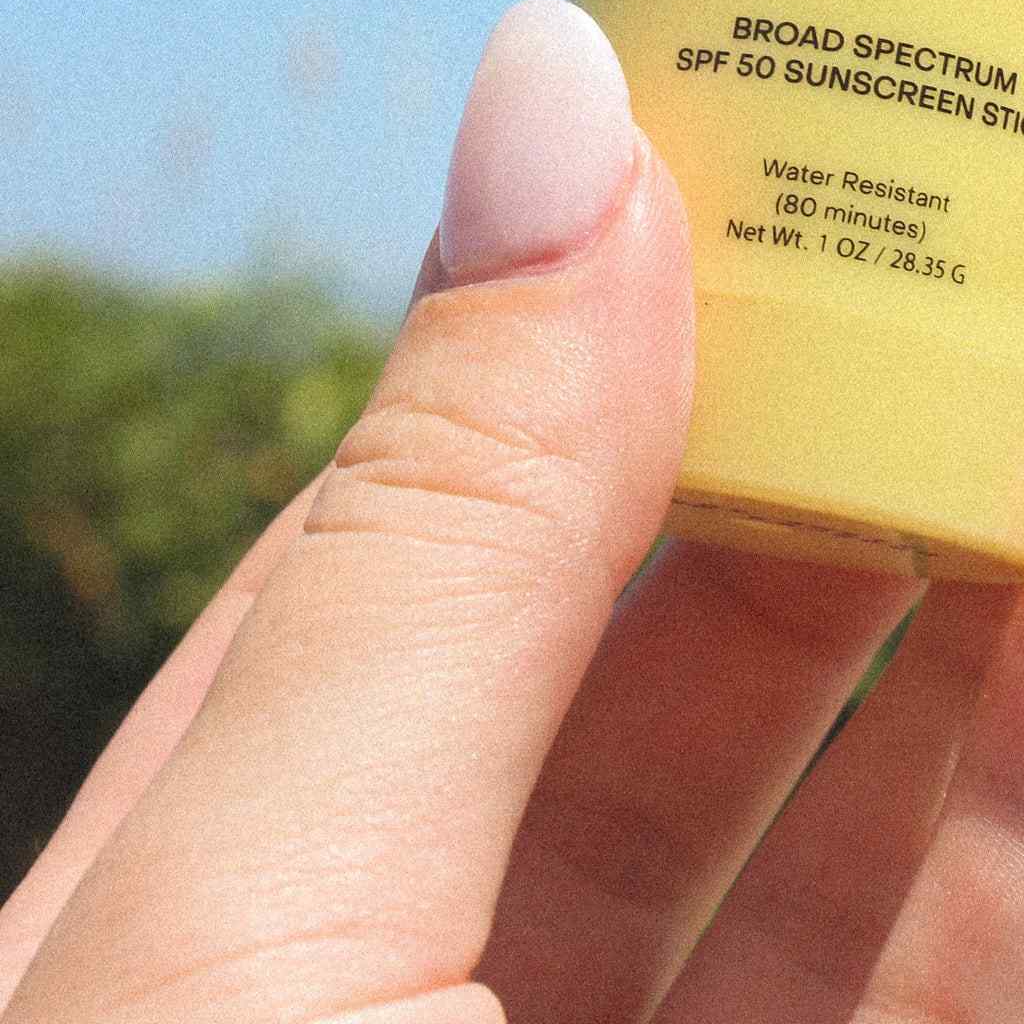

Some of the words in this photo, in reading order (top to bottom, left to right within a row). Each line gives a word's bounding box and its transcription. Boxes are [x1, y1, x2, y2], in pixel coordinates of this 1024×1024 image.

[676, 47, 731, 73] SPF
[736, 53, 776, 80] 50
[783, 59, 975, 120] SUNSCREEN
[732, 16, 845, 53] BROAD
[852, 33, 1018, 96] SPECTRUM
[763, 158, 835, 187] Water
[841, 171, 951, 213] Resistant
[775, 192, 817, 218] (80
[824, 204, 927, 244] minutes)
[726, 218, 767, 244] Net
[772, 225, 809, 251] Wt.
[820, 234, 827, 253] 1
[836, 237, 871, 262] OZ
[874, 246, 886, 265] /
[889, 248, 946, 280] 28.35
[951, 264, 967, 285] G
